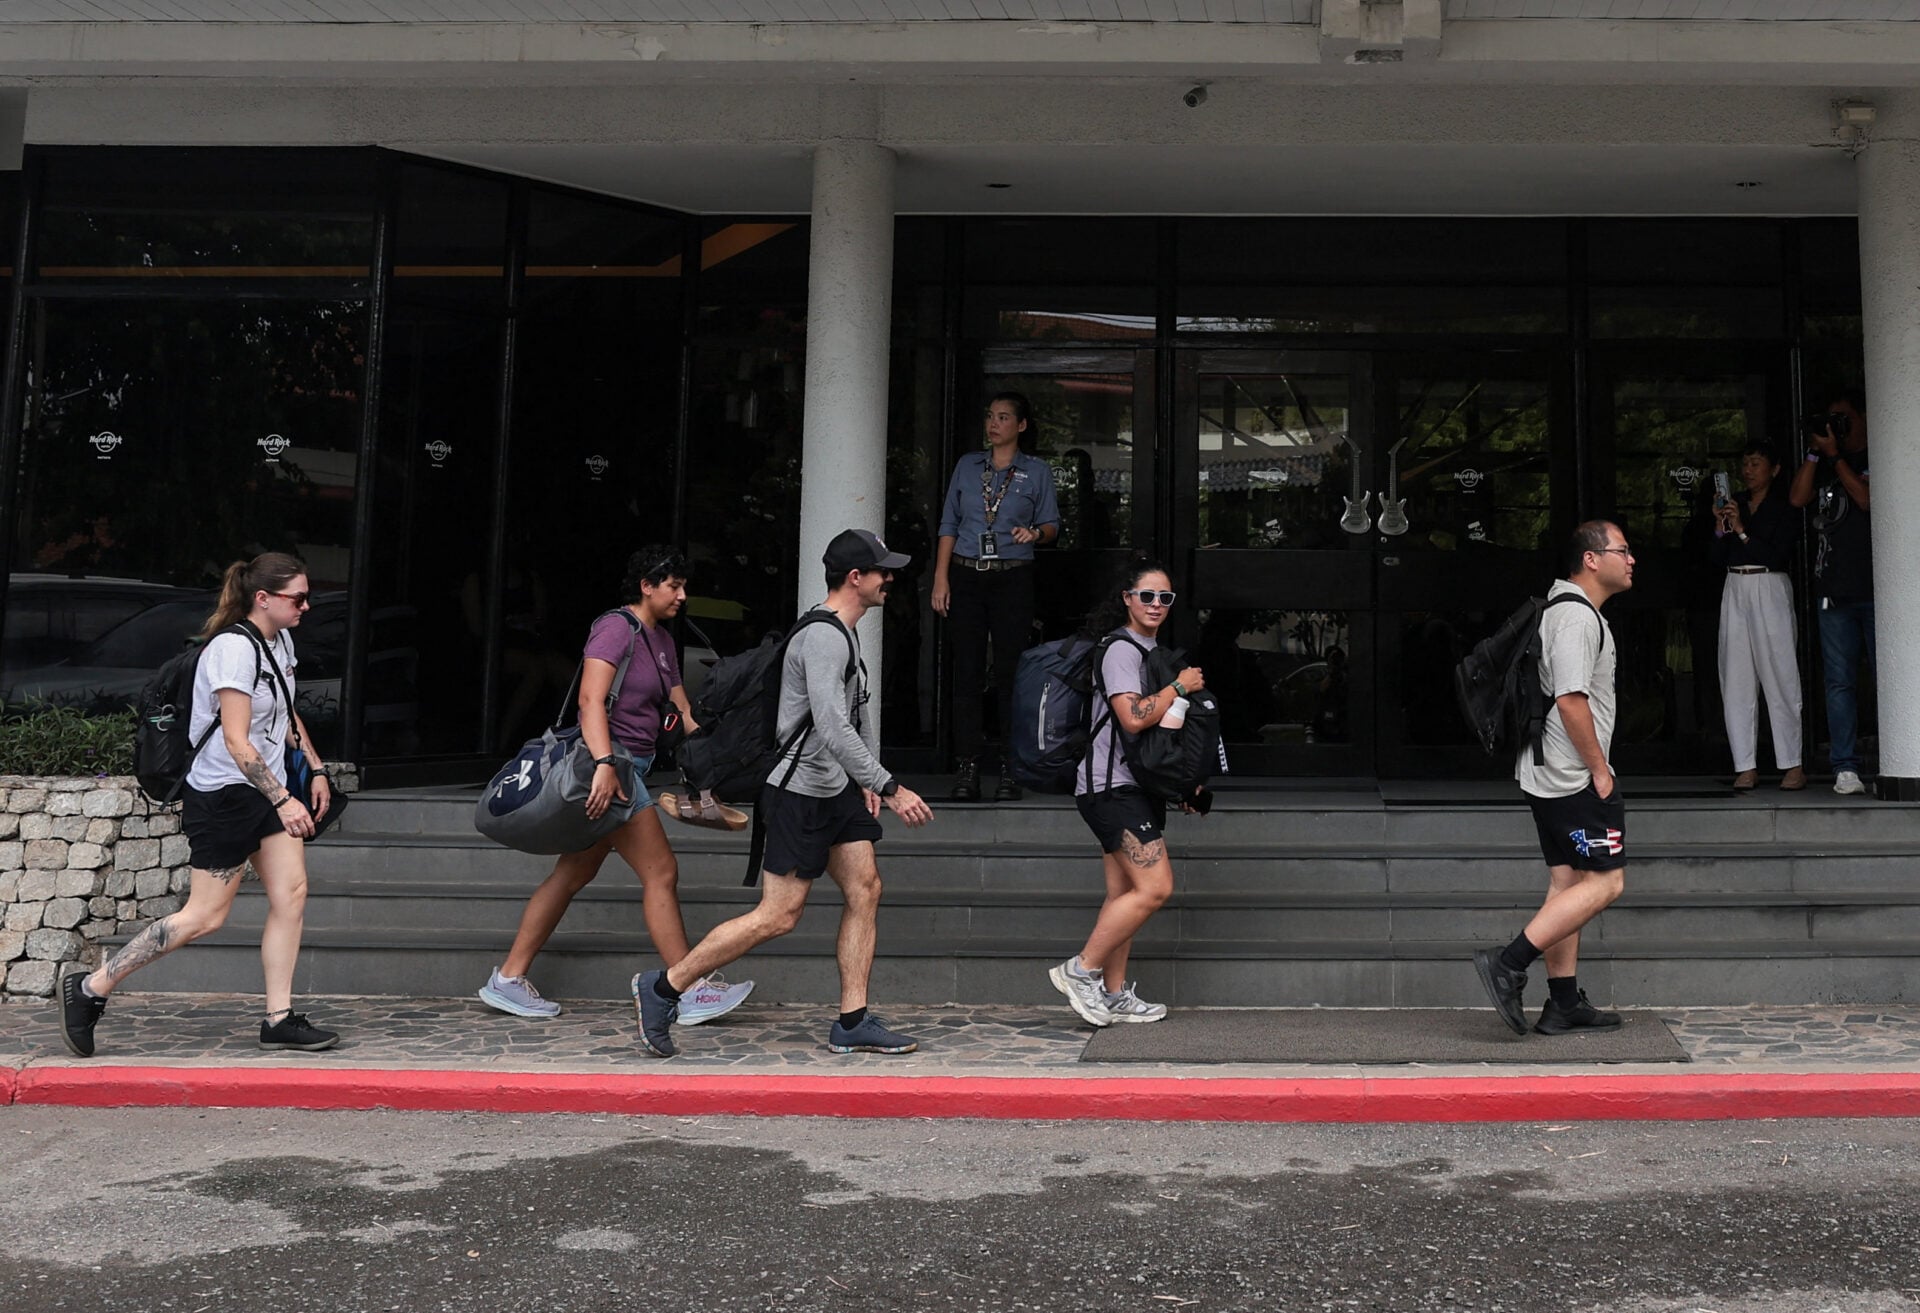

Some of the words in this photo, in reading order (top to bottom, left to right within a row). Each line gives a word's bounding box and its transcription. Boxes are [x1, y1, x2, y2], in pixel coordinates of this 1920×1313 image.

[89, 435, 106, 443] Hard
[106, 435, 122, 445] Rock
[257, 438, 274, 446] Hard
[274, 438, 291, 447] Rock
[1454, 472, 1469, 480] Hard
[695, 994, 721, 1004] HOKA
